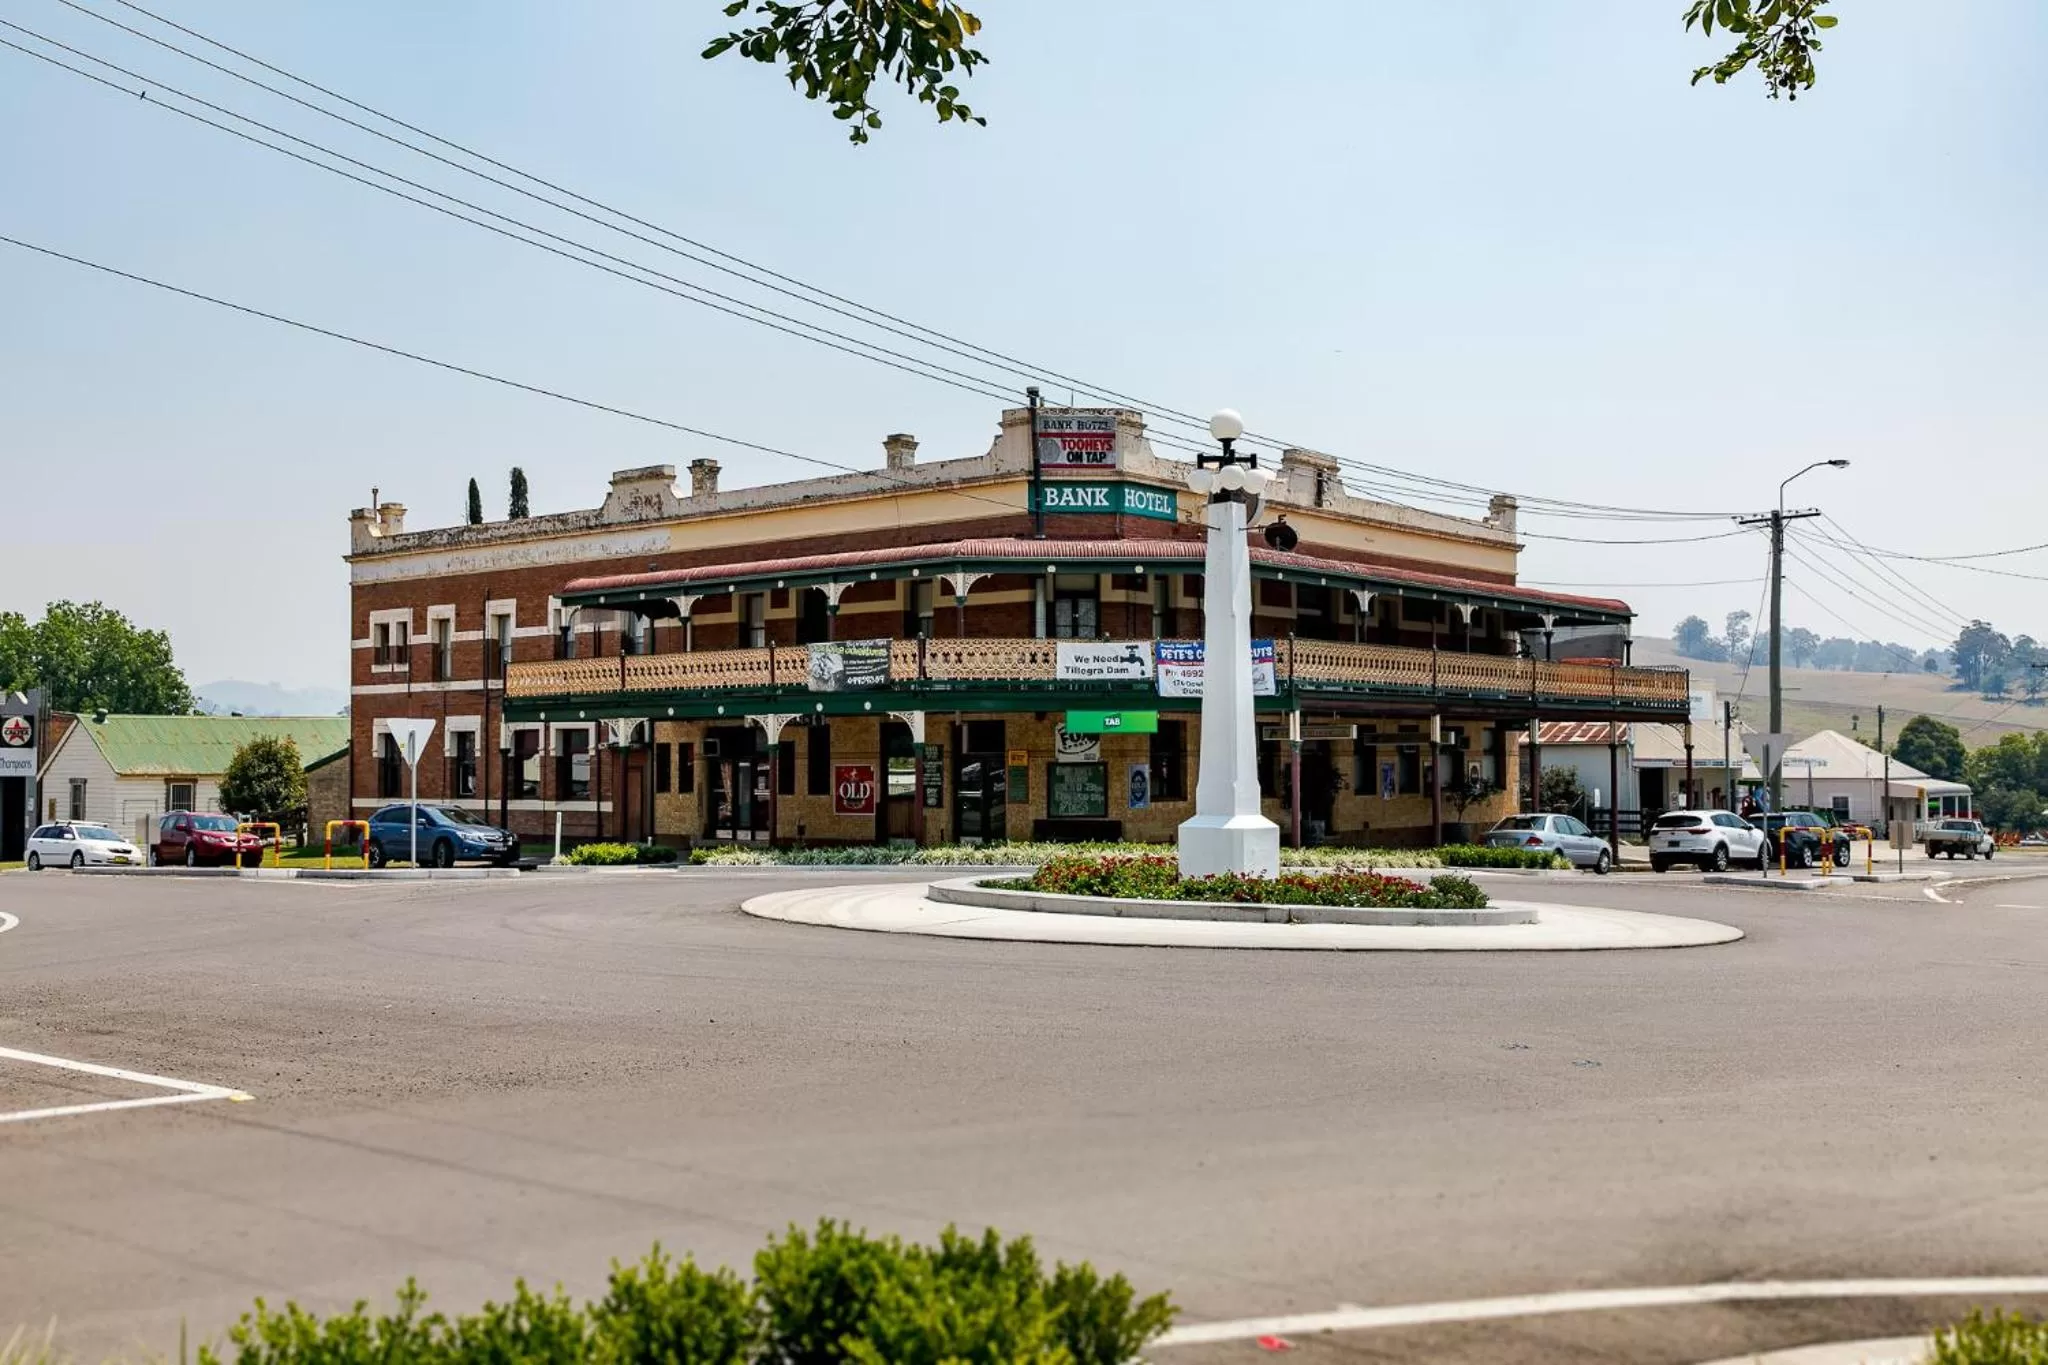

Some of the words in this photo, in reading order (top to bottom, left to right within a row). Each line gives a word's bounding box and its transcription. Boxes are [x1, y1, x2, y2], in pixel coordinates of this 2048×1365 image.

[1043, 420, 1072, 430] BANK
[1077, 420, 1112, 430] HOTEL
[1060, 439, 1113, 451] TOOHEYS
[1067, 452, 1083, 463] ON
[1086, 452, 1107, 463] TAP
[1044, 487, 1109, 507] BANK
[1124, 488, 1171, 514] HOTEL
[1160, 649, 1194, 660] PETE'S
[1252, 647, 1273, 657] UTS
[1074, 655, 1090, 663] We
[1093, 655, 1118, 663] Need
[1107, 666, 1129, 674] Dam
[1104, 718, 1121, 726] TAB
[839, 781, 871, 800] OLD
